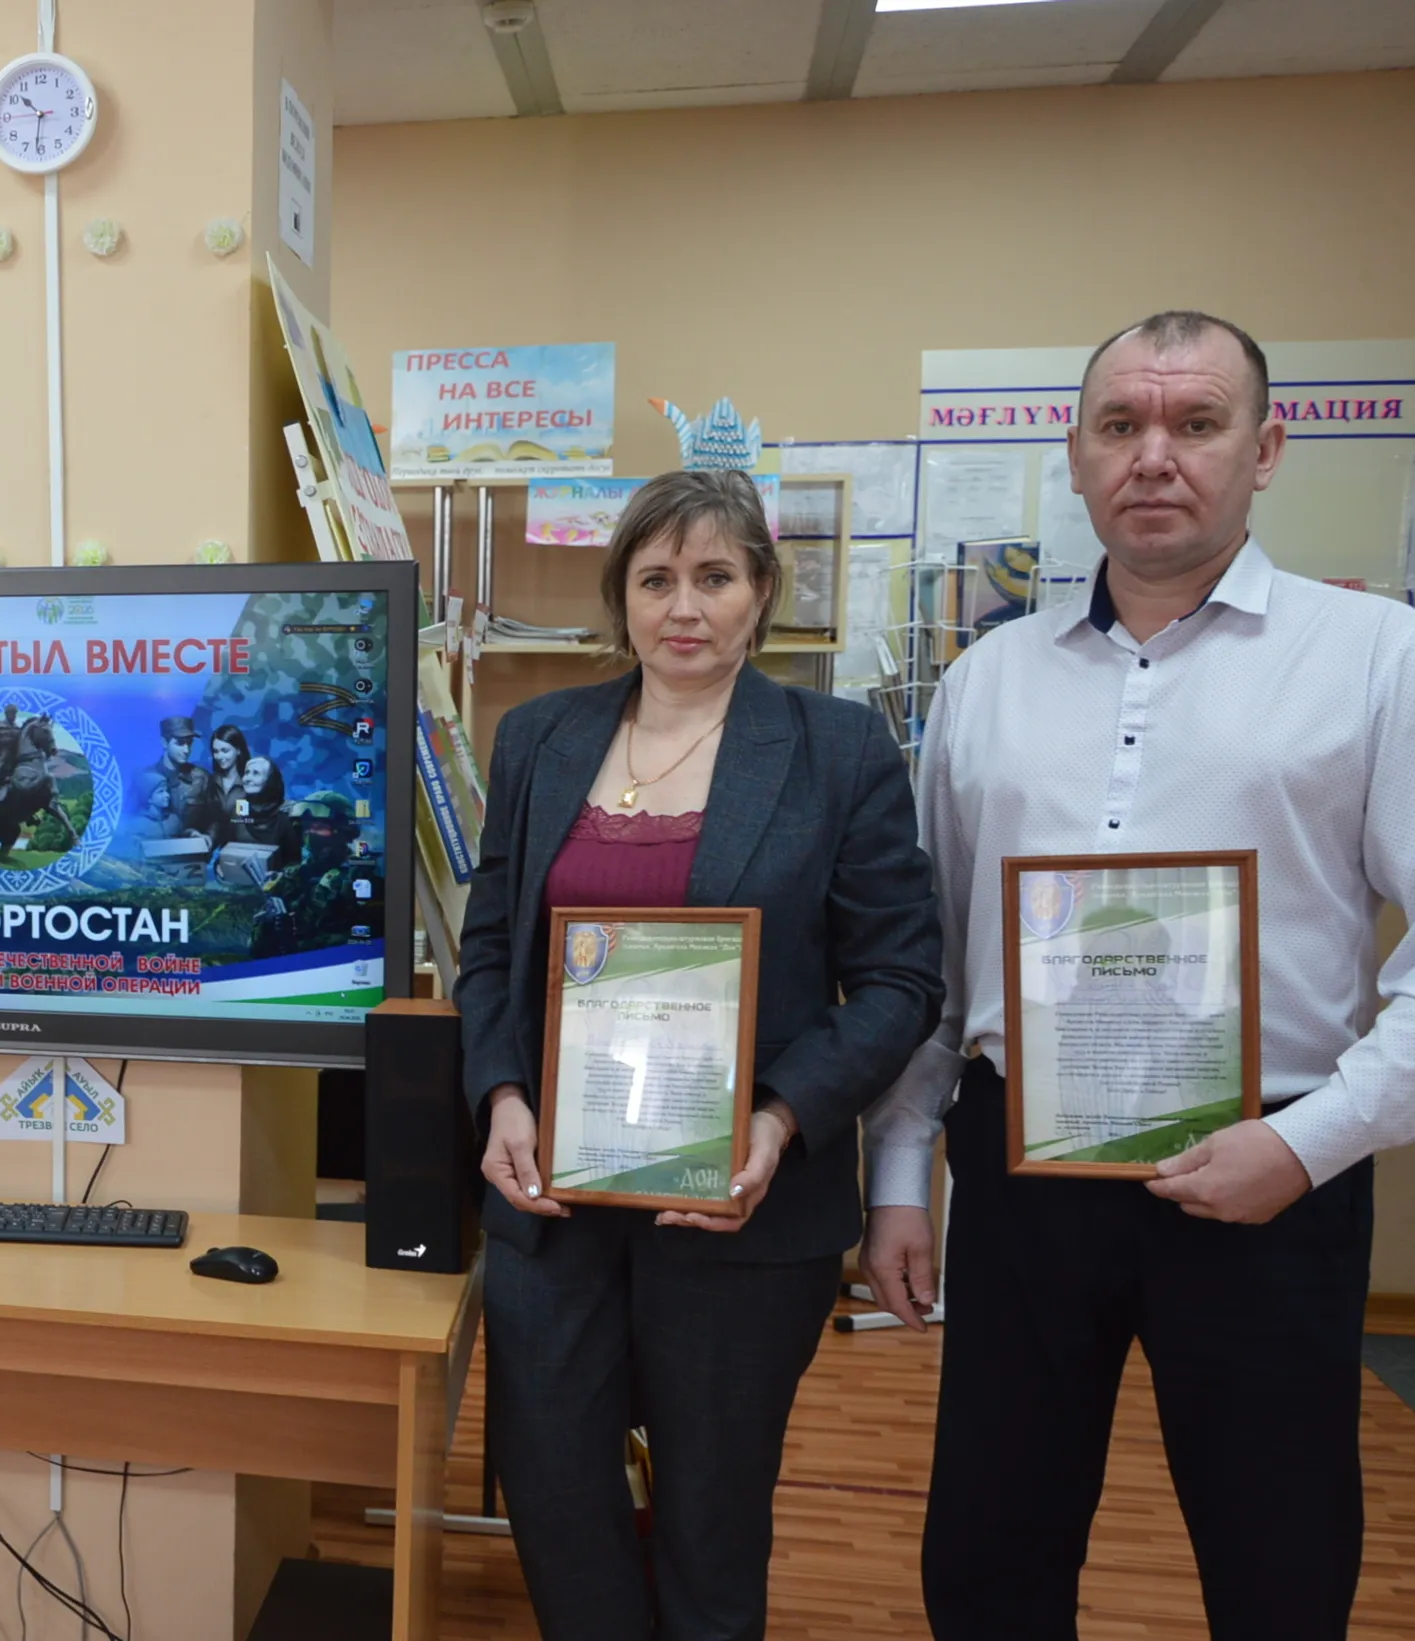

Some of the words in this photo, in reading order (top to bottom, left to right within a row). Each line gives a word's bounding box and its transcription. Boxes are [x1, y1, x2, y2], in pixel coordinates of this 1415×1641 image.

[35, 74, 47, 85] 12
[55, 78, 60, 88] 1
[20, 81, 28, 92] 11
[9, 94, 19, 105] 10
[66, 89, 74, 99] 2
[3, 112, 11, 122] 9
[70, 107, 79, 117] 3
[9, 130, 17, 141] 8
[64, 125, 73, 135] 4
[22, 142, 29, 152] 7
[54, 139, 62, 149] 5
[38, 145, 45, 155] 6
[406, 351, 510, 371] ПРЕССА
[439, 383, 477, 400] НА
[486, 380, 536, 399] ВСЕ
[1272, 398, 1404, 423] МАЦИЯ
[442, 409, 593, 431] ИНТЕРЕСЫ
[535, 486, 622, 500] ЖУРНАЛЫ
[86, 638, 250, 674] ВМЕСТЕ
[137, 952, 201, 974] ВОЙНЕ
[1041, 954, 1209, 966] БЛАГОДАРСТВЕННОЕ
[1091, 966, 1157, 977] ПИСЬМО
[9, 972, 98, 992] ВОЕННОЙ
[102, 978, 201, 997] ОПЕРАЦИИ
[577, 999, 712, 1012] БЛАГОДАРСТВЕННОЕ
[617, 1011, 671, 1022] ПИСЬМО
[72, 1071, 100, 1100] АУЫЛ
[70, 1122, 99, 1133] СЕЛО
